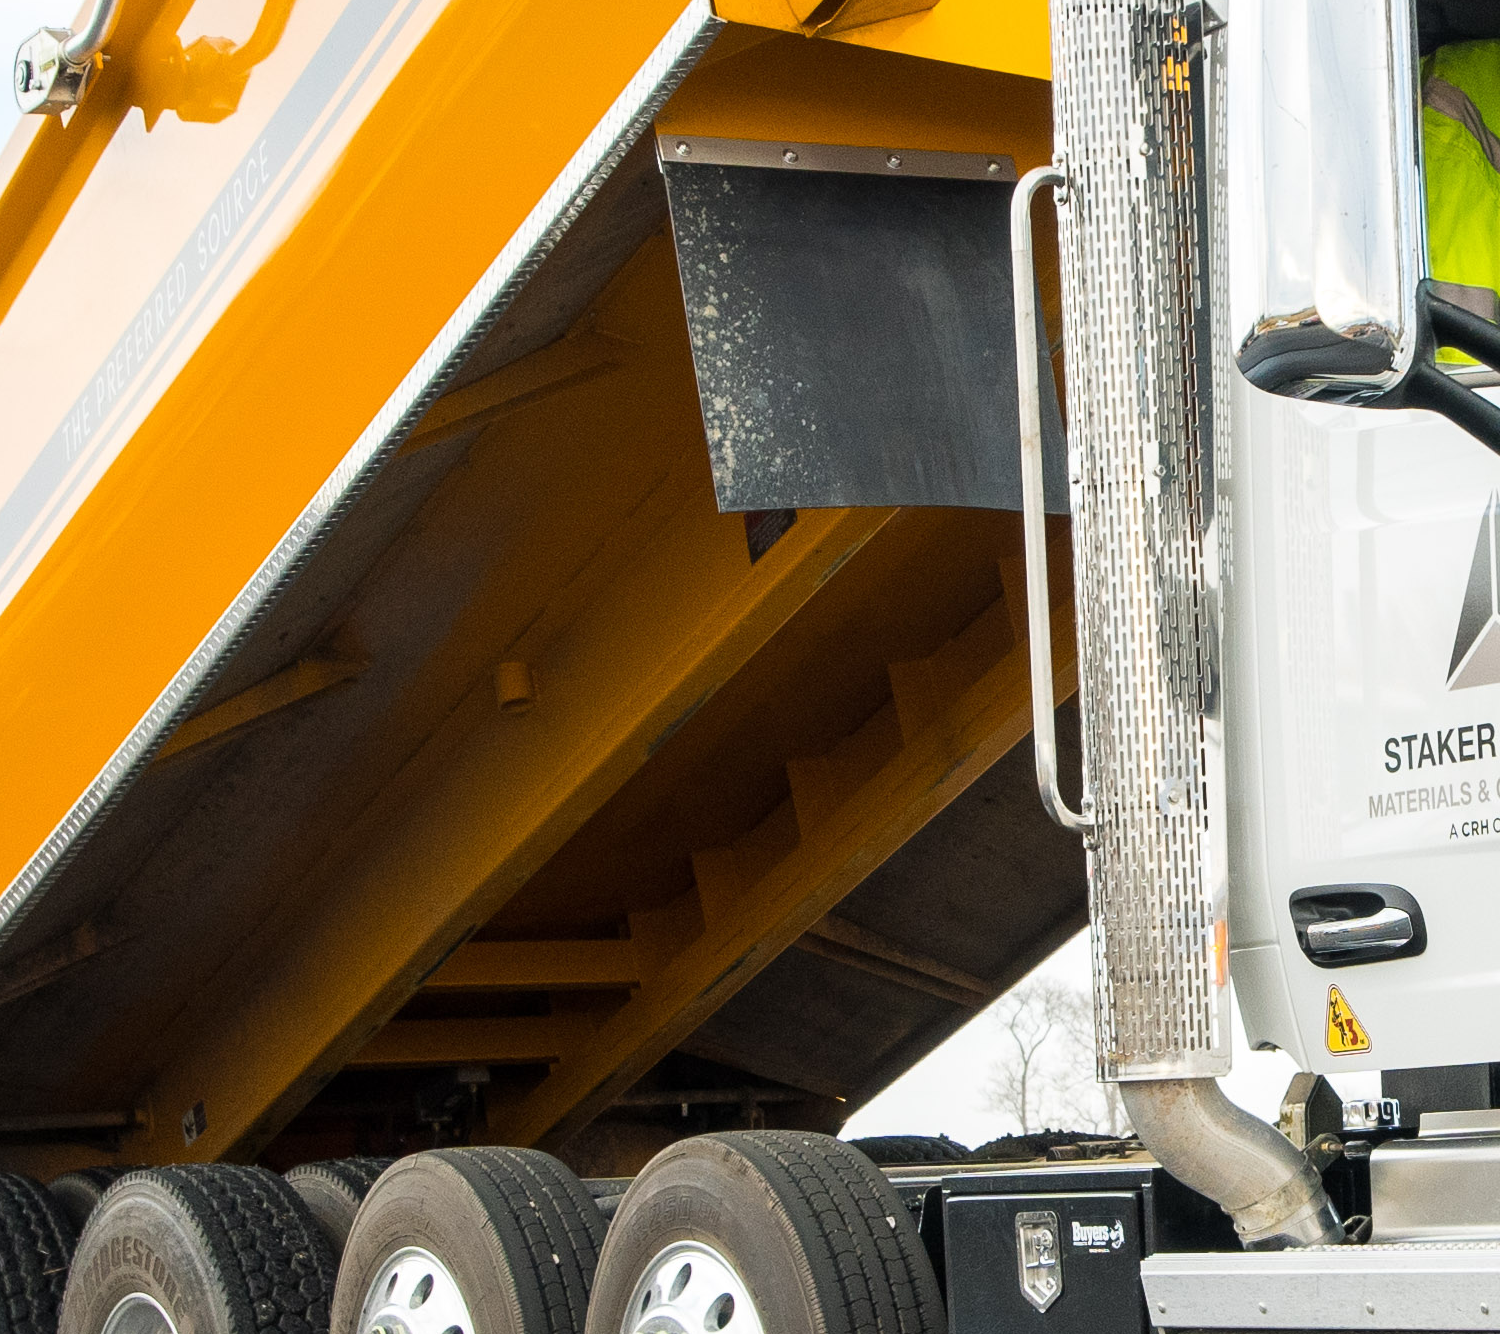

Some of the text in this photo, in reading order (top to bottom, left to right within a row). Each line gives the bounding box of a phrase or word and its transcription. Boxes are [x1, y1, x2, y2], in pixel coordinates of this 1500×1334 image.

[61, 139, 271, 462] THE PREFERRED SOURCE
[1384, 721, 1496, 773] STAKER
[1368, 781, 1473, 819] MATERIALS
[1477, 780, 1491, 803] &
[1449, 820, 1459, 839] A
[1461, 818, 1490, 837] CRH
[1071, 1221, 1110, 1246] Buyers
